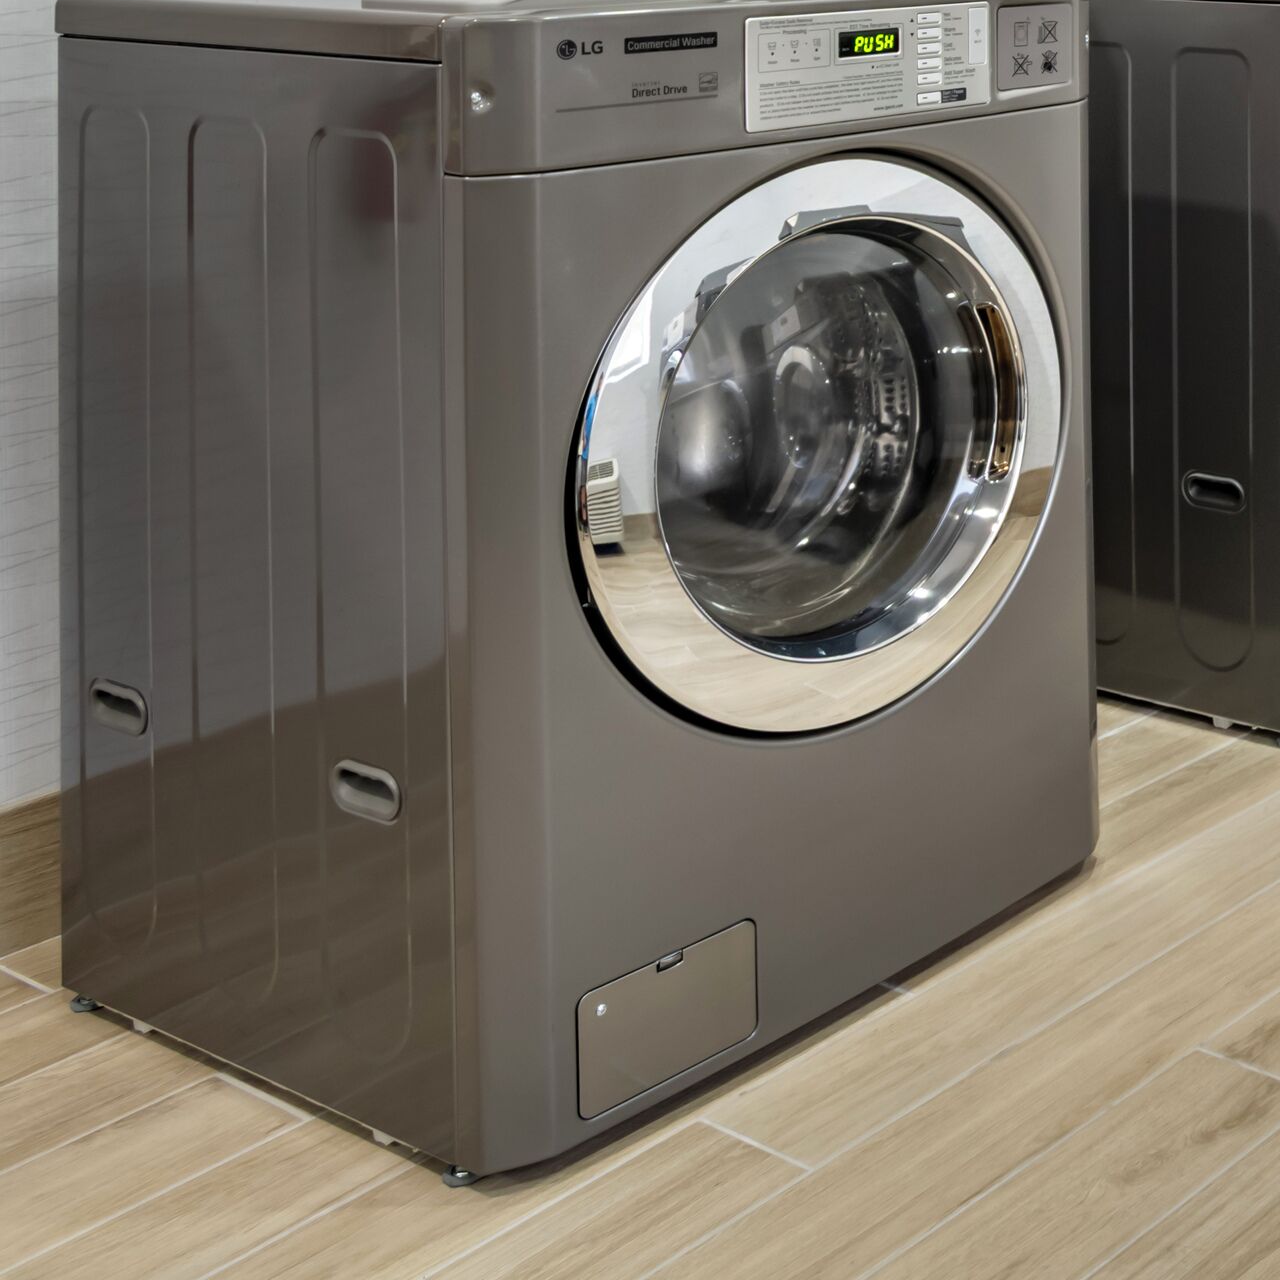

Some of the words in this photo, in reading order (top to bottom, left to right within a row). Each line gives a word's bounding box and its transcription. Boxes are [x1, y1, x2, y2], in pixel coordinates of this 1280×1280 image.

[581, 40, 604, 55] LG
[627, 39, 680, 51] Commercial
[682, 36, 715, 47] Washer
[854, 33, 895, 53] PUSH
[632, 86, 661, 98] Direct
[663, 85, 688, 95] Drive
